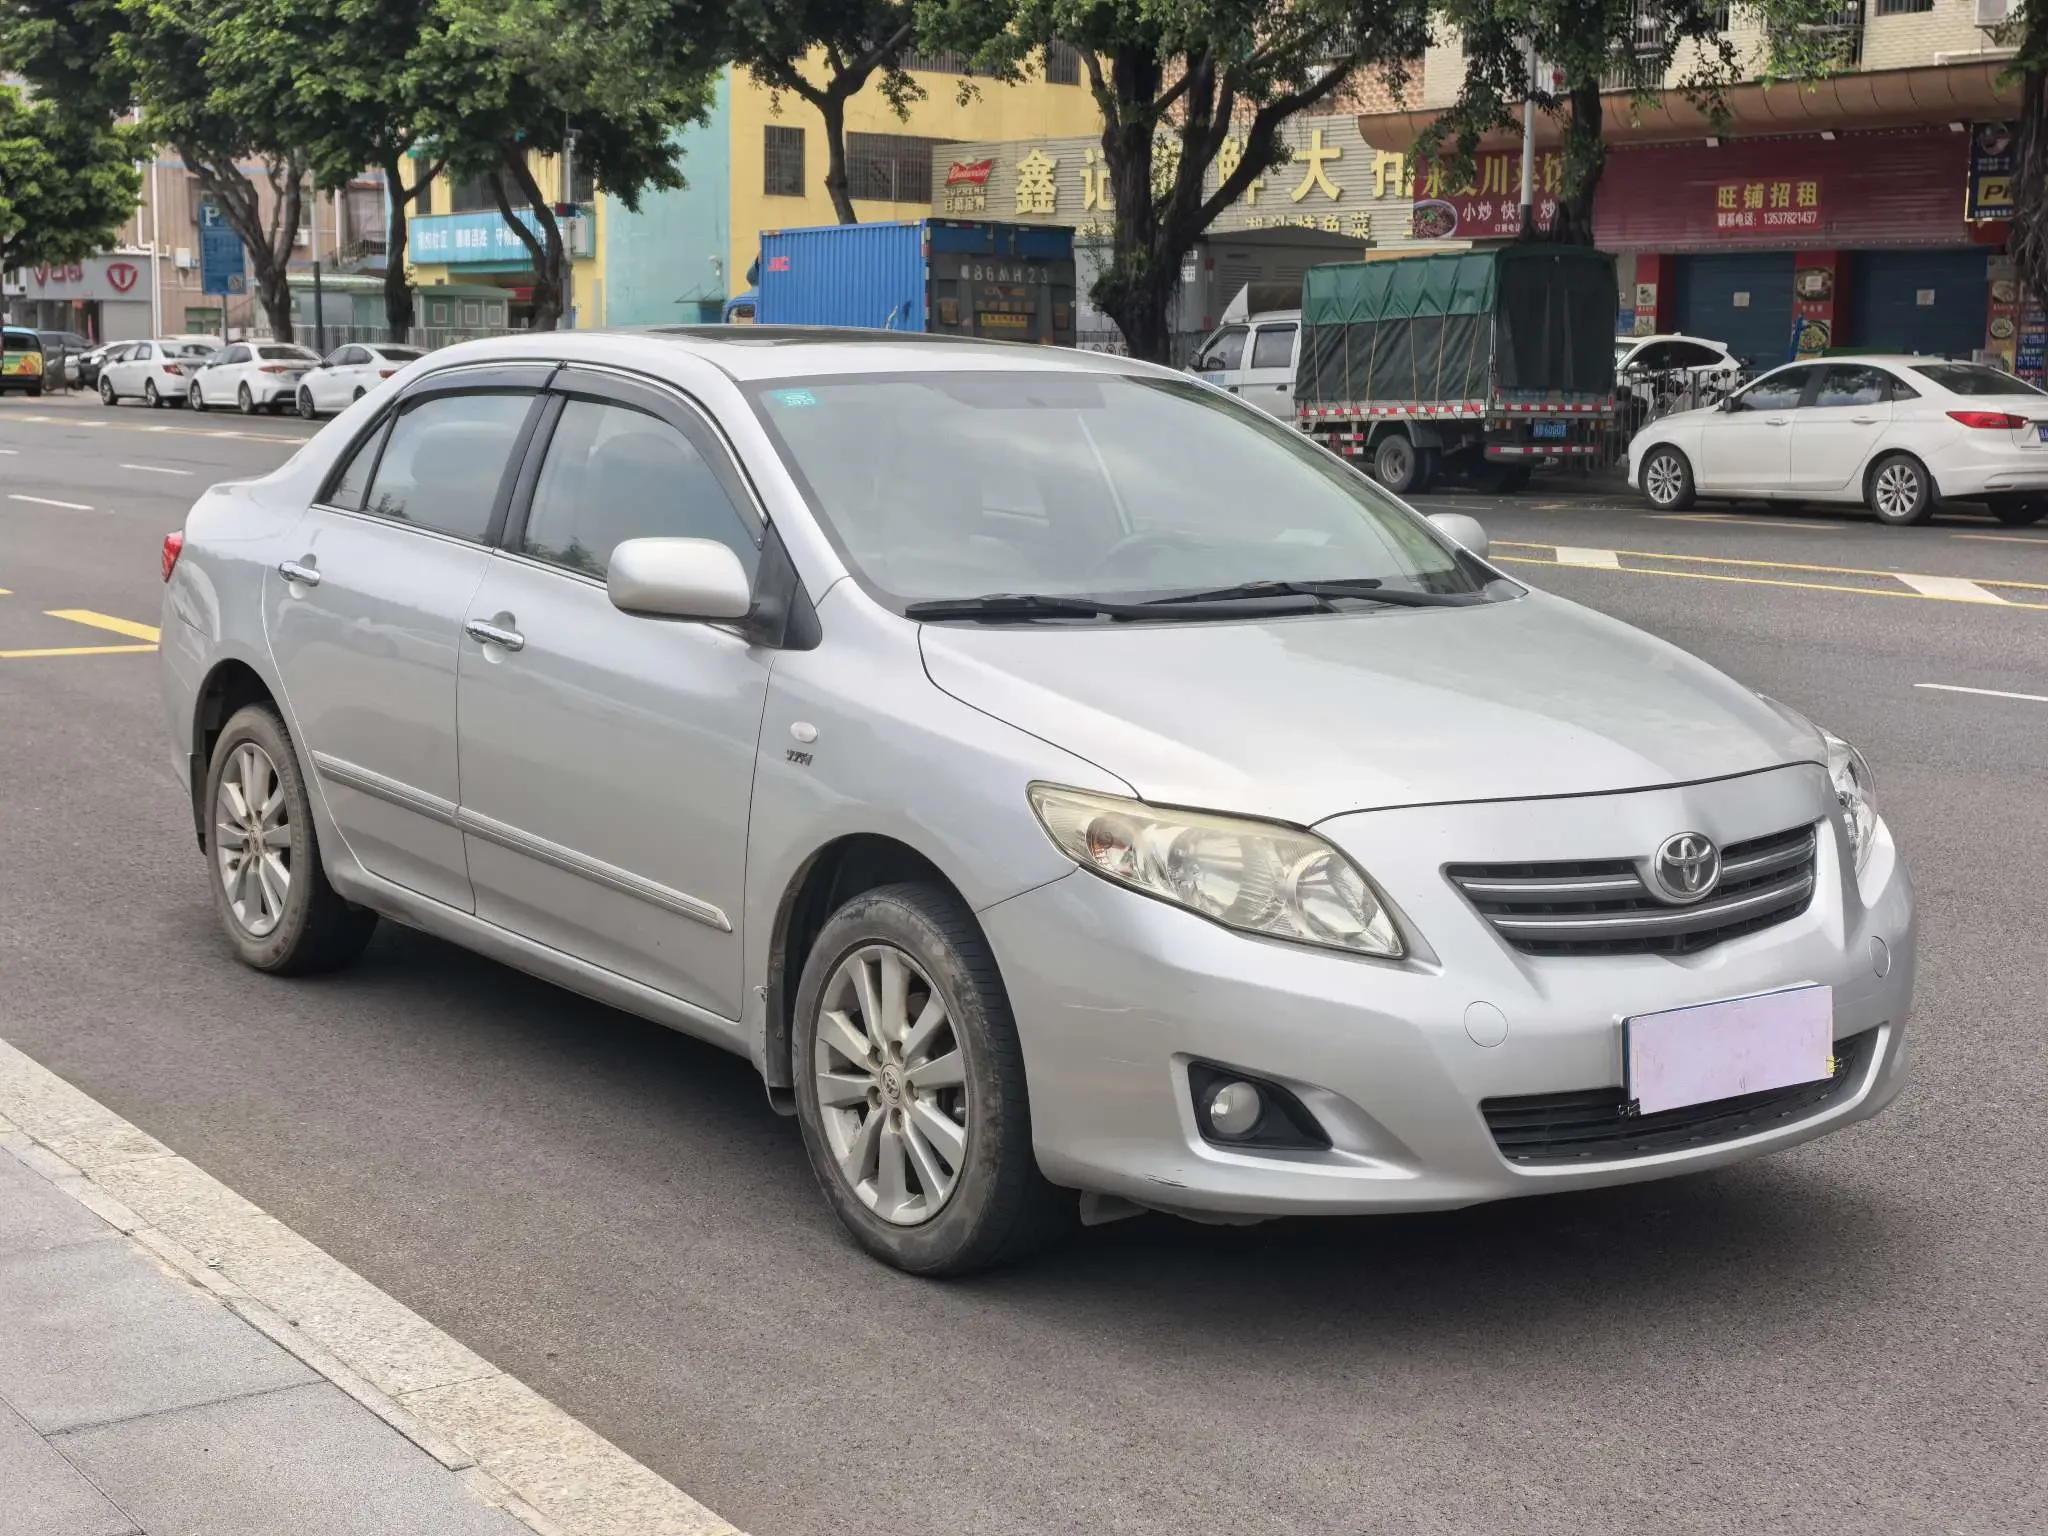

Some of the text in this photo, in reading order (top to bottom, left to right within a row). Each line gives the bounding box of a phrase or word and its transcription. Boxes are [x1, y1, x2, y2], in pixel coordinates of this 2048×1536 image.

[1718, 181, 1817, 209] 旺铺招租
[204, 206, 220, 227] P
[1462, 201, 1493, 222] 小炒
